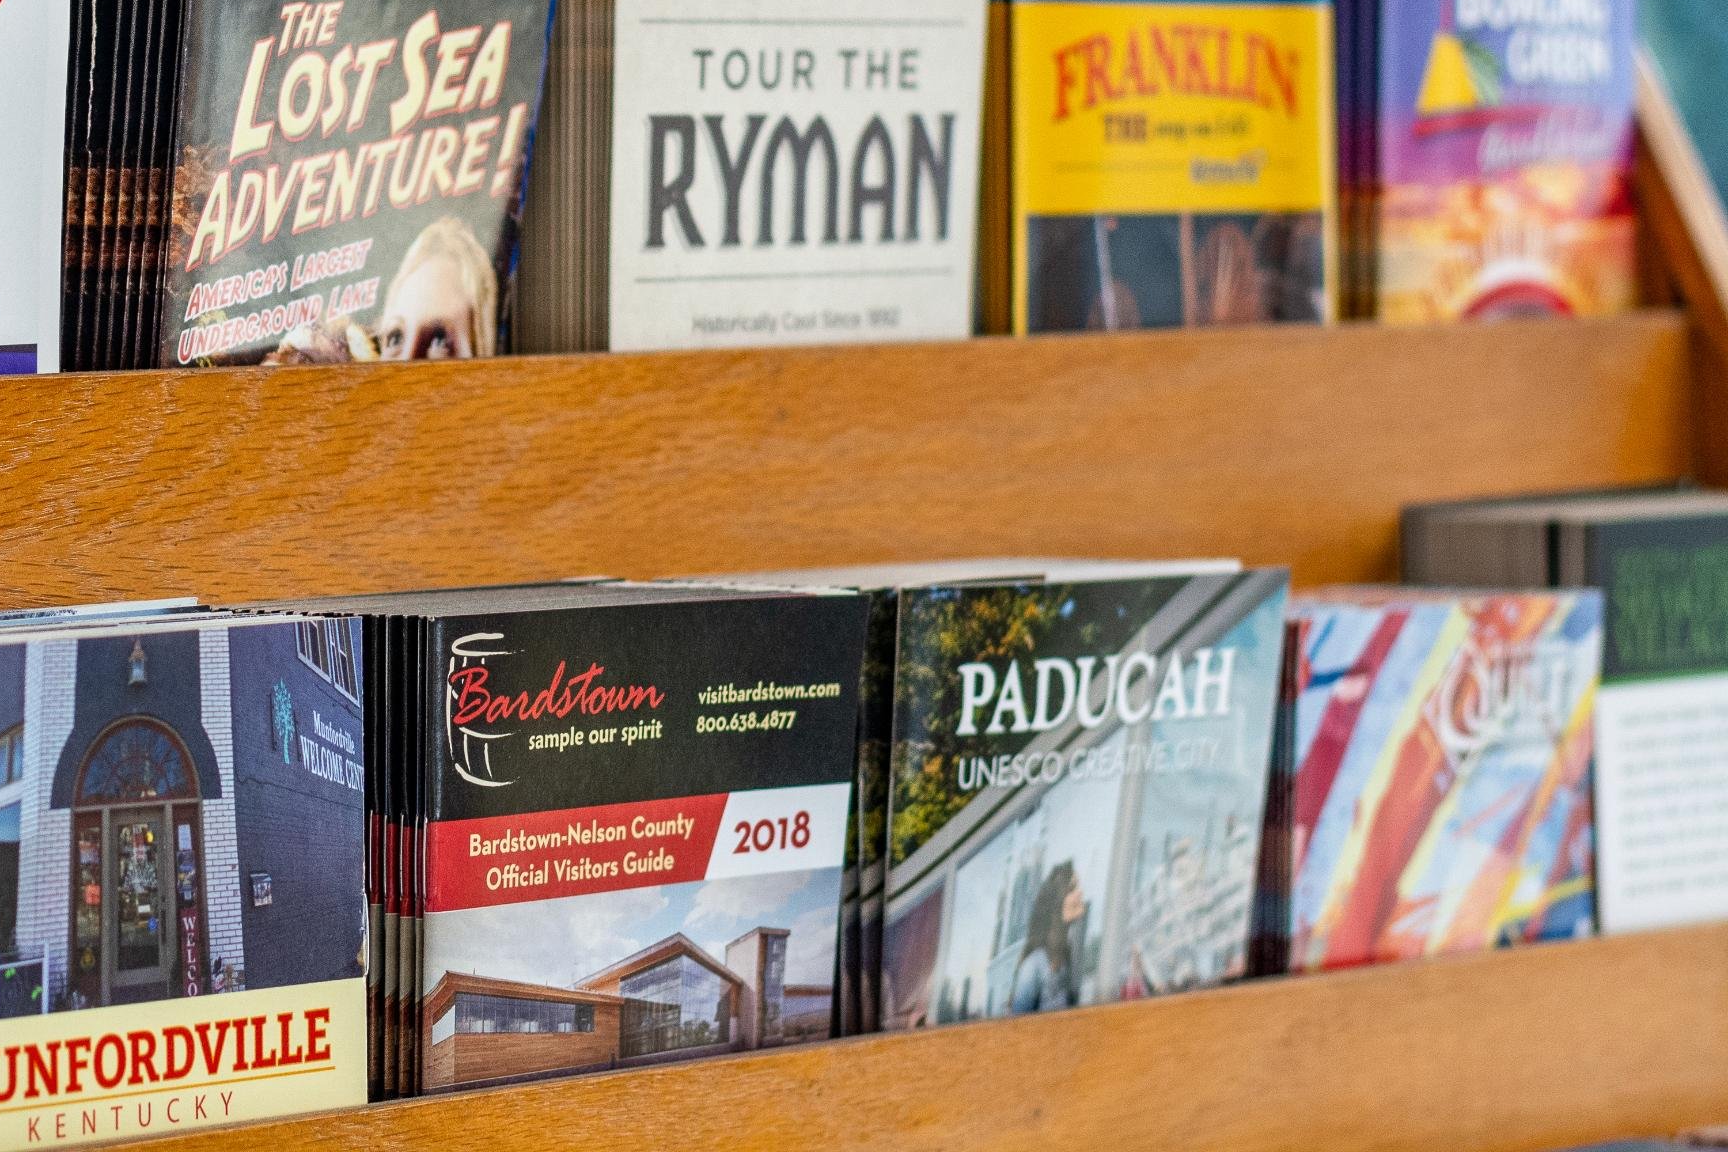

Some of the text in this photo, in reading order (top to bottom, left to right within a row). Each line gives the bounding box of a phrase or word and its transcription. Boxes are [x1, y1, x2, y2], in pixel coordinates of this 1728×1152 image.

[277, 0, 345, 57] THE
[691, 47, 922, 92] TOUR THE
[1052, 22, 1301, 126] FRANKLIN
[1505, 29, 1610, 85] GREEN
[229, 9, 512, 164] LOST SEA
[184, 101, 528, 273] ADVENTURE!
[643, 111, 957, 250] RYMAN
[184, 238, 373, 323] AMERICA'S LARGEST
[176, 276, 381, 366] UNDERGROUND LAKE
[449, 660, 667, 726] Bardstown
[697, 680, 842, 707] visitbardstown.com
[955, 646, 1237, 737] PADUCAH
[312, 709, 356, 756] Munfordville
[528, 718, 663, 752] sample our spirit
[695, 710, 798, 735] 800.638.4877
[300, 734, 345, 785] WELCOME
[957, 750, 1063, 793] UNESCO
[469, 812, 696, 858] Bardstown-Nelson County
[731, 810, 812, 856] 2018
[485, 848, 676, 892] Official Visitors Guide
[27, 1090, 236, 1144] KENTUCKY
